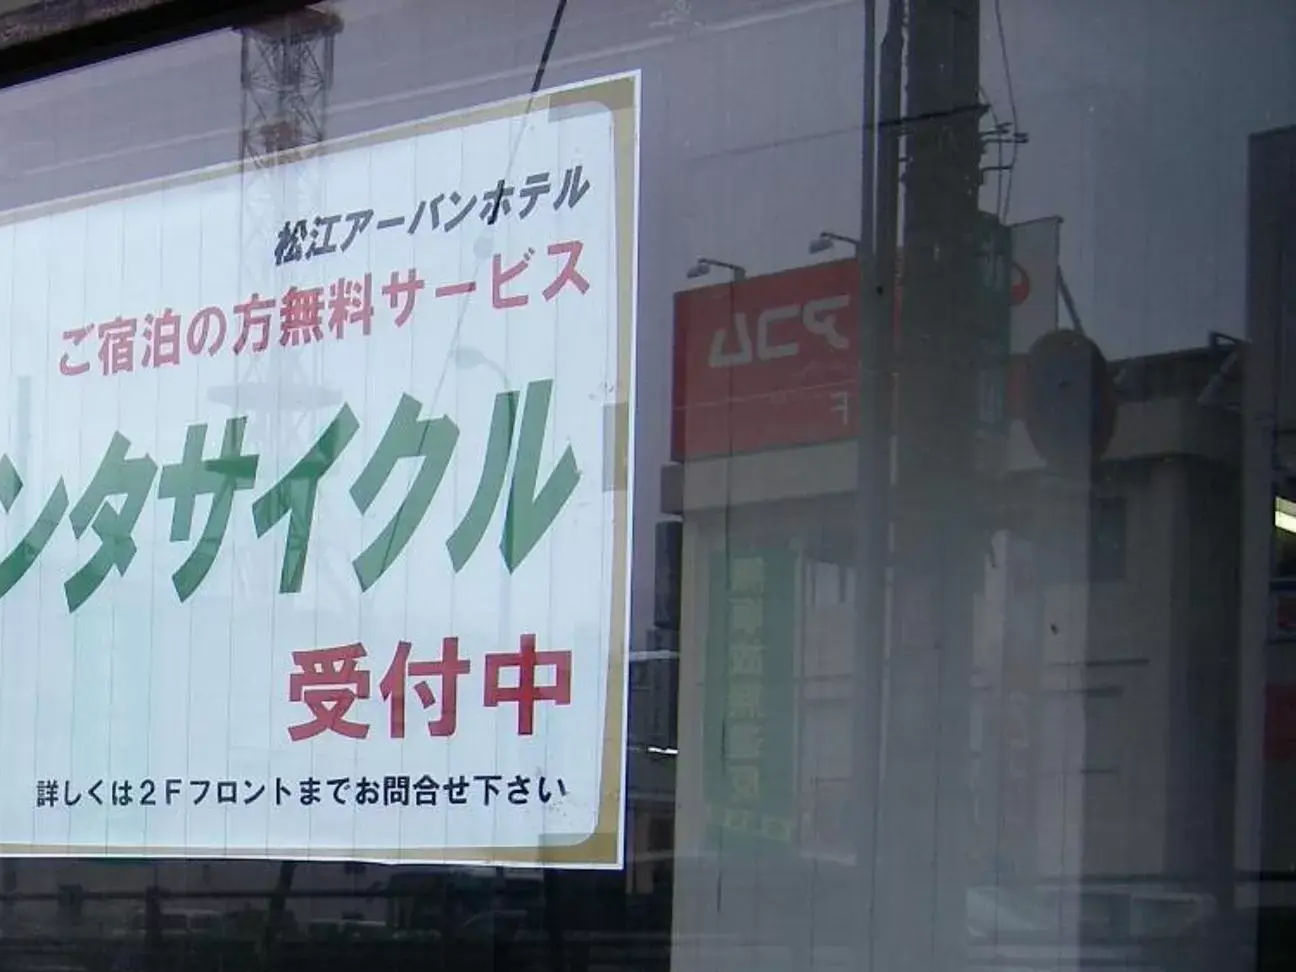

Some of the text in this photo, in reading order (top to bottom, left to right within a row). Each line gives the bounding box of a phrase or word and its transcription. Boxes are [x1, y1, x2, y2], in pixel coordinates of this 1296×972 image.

[274, 164, 591, 266] 松江アーバンホテル
[58, 241, 591, 377] ご宿泊の方無料サービス
[286, 633, 573, 742] 受付中
[34, 773, 568, 808] 詳しくは2Fフロントまでお問合せ下さい
